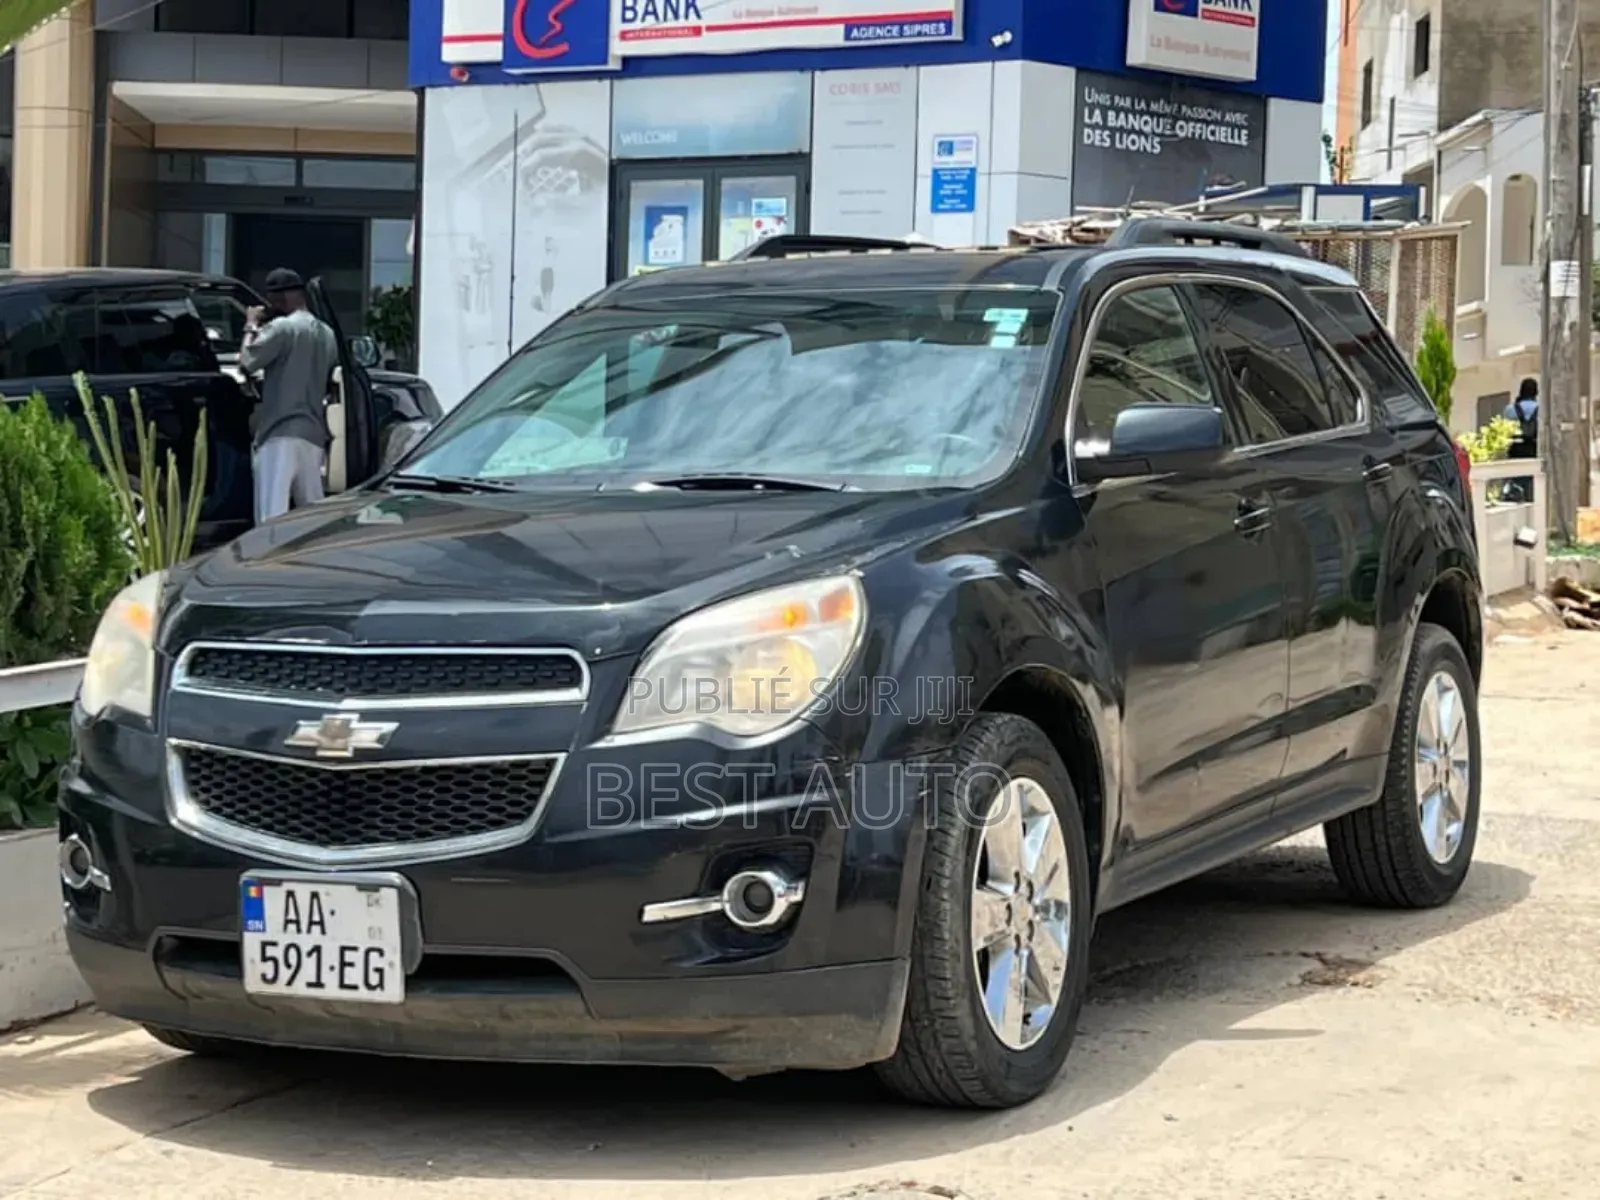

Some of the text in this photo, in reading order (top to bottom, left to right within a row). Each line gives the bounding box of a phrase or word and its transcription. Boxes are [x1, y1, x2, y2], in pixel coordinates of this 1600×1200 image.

[621, 0, 702, 23] BANK
[851, 23, 946, 38] AGENCE SIPRES
[1114, 95, 1132, 110] PAR
[1135, 98, 1147, 111] LA
[1181, 104, 1222, 121] PASSION
[1224, 112, 1249, 126] AVEC
[619, 130, 678, 146] WELCOME
[1083, 107, 1249, 147] LA BANQUE OFFICIELLE
[1083, 128, 1161, 154] DES LIONS
